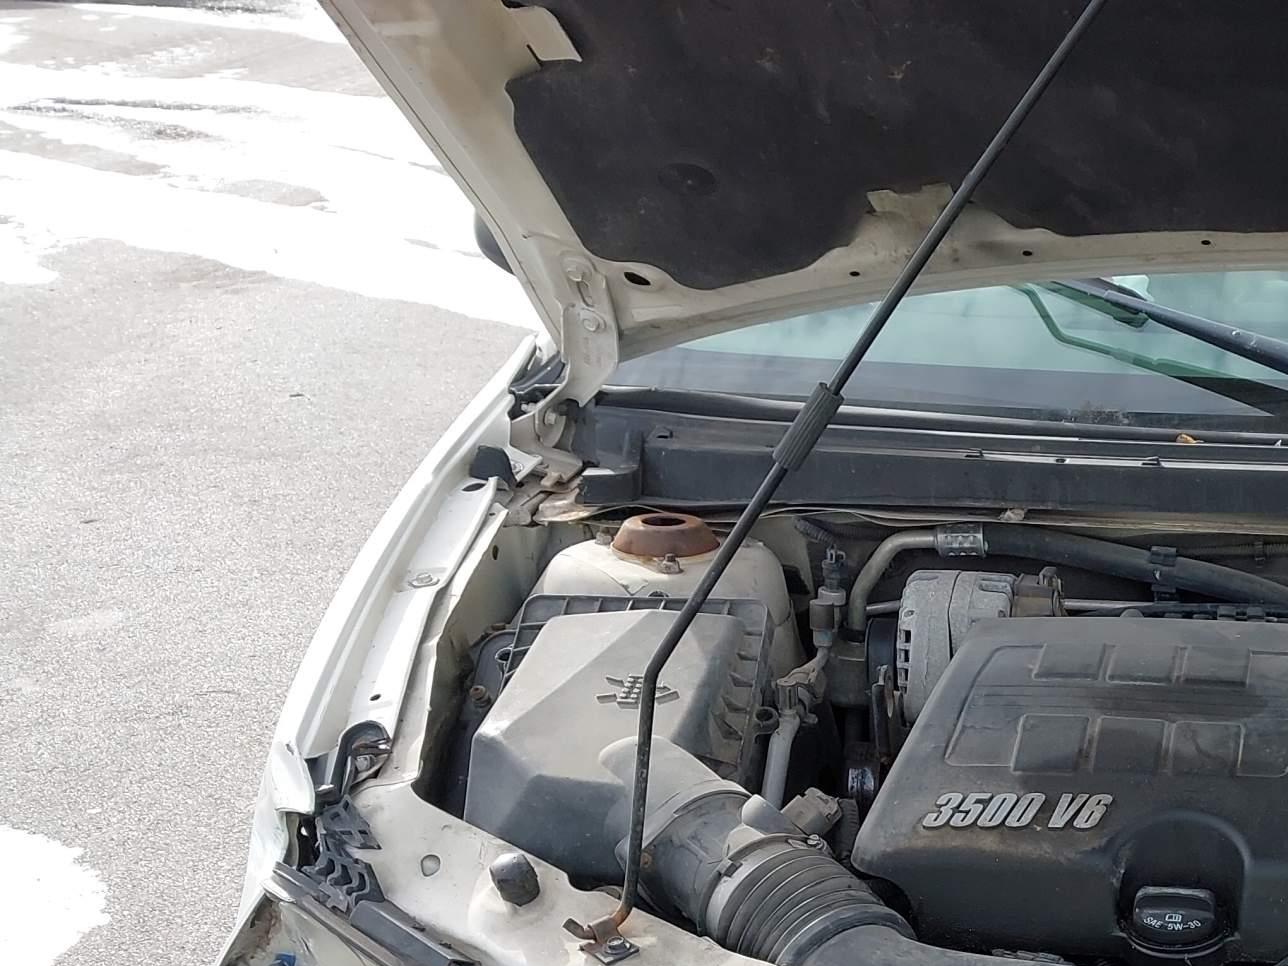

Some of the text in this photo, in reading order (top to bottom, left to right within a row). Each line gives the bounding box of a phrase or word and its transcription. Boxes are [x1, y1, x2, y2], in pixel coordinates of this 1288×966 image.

[922, 792, 1113, 829] 3500 V6
[1143, 916, 1202, 931] SAE 5W-30
